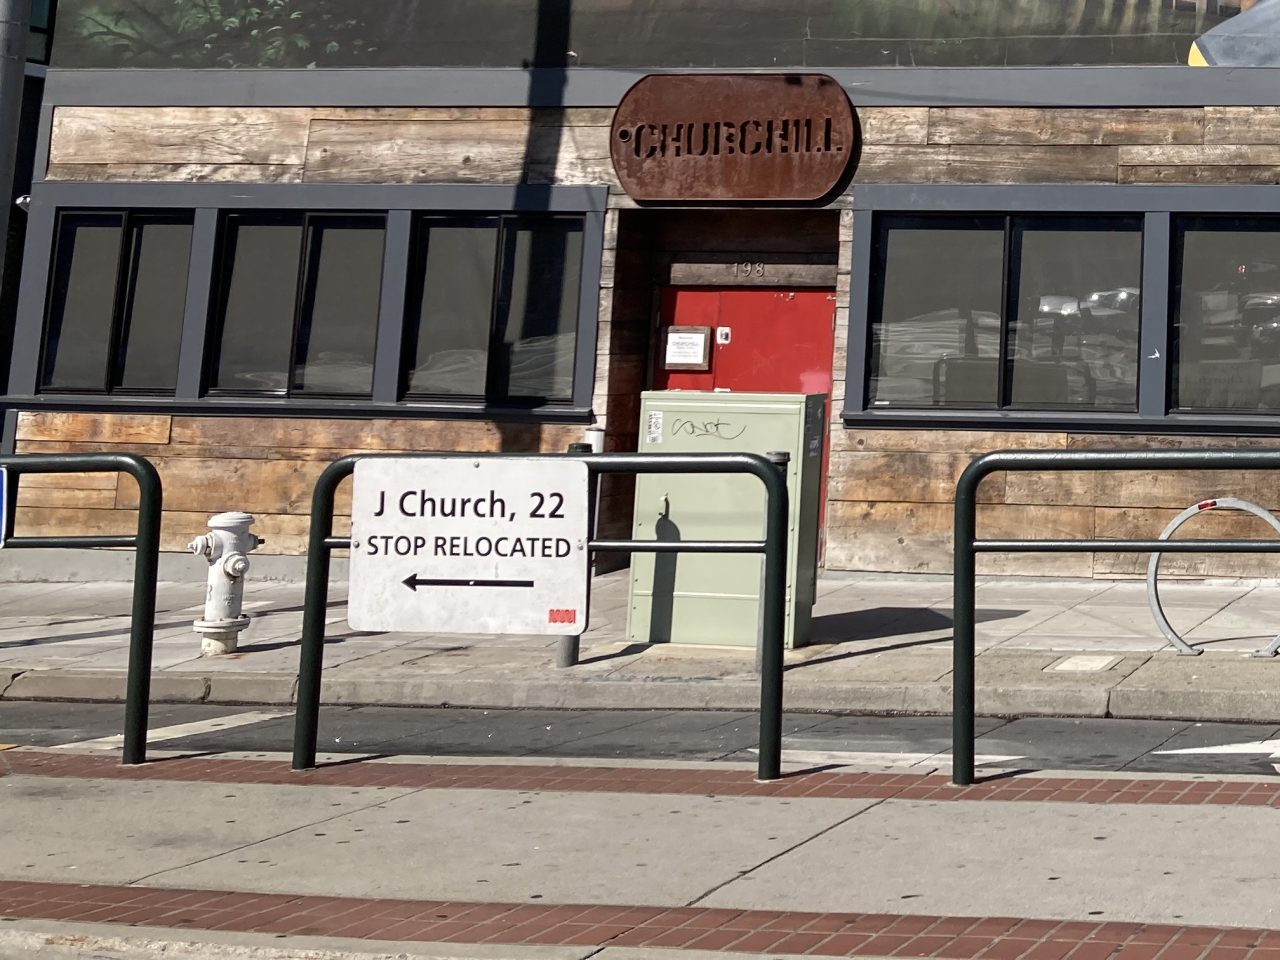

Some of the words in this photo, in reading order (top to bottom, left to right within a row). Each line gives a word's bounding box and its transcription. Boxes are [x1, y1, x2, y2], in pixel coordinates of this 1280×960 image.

[634, 117, 844, 159] CHURCHILL
[733, 261, 766, 278] 198
[373, 490, 386, 518] J
[399, 489, 516, 522] Church,
[529, 491, 565, 519] 22
[367, 535, 426, 557] STOP
[434, 535, 571, 558] RELOCATED
